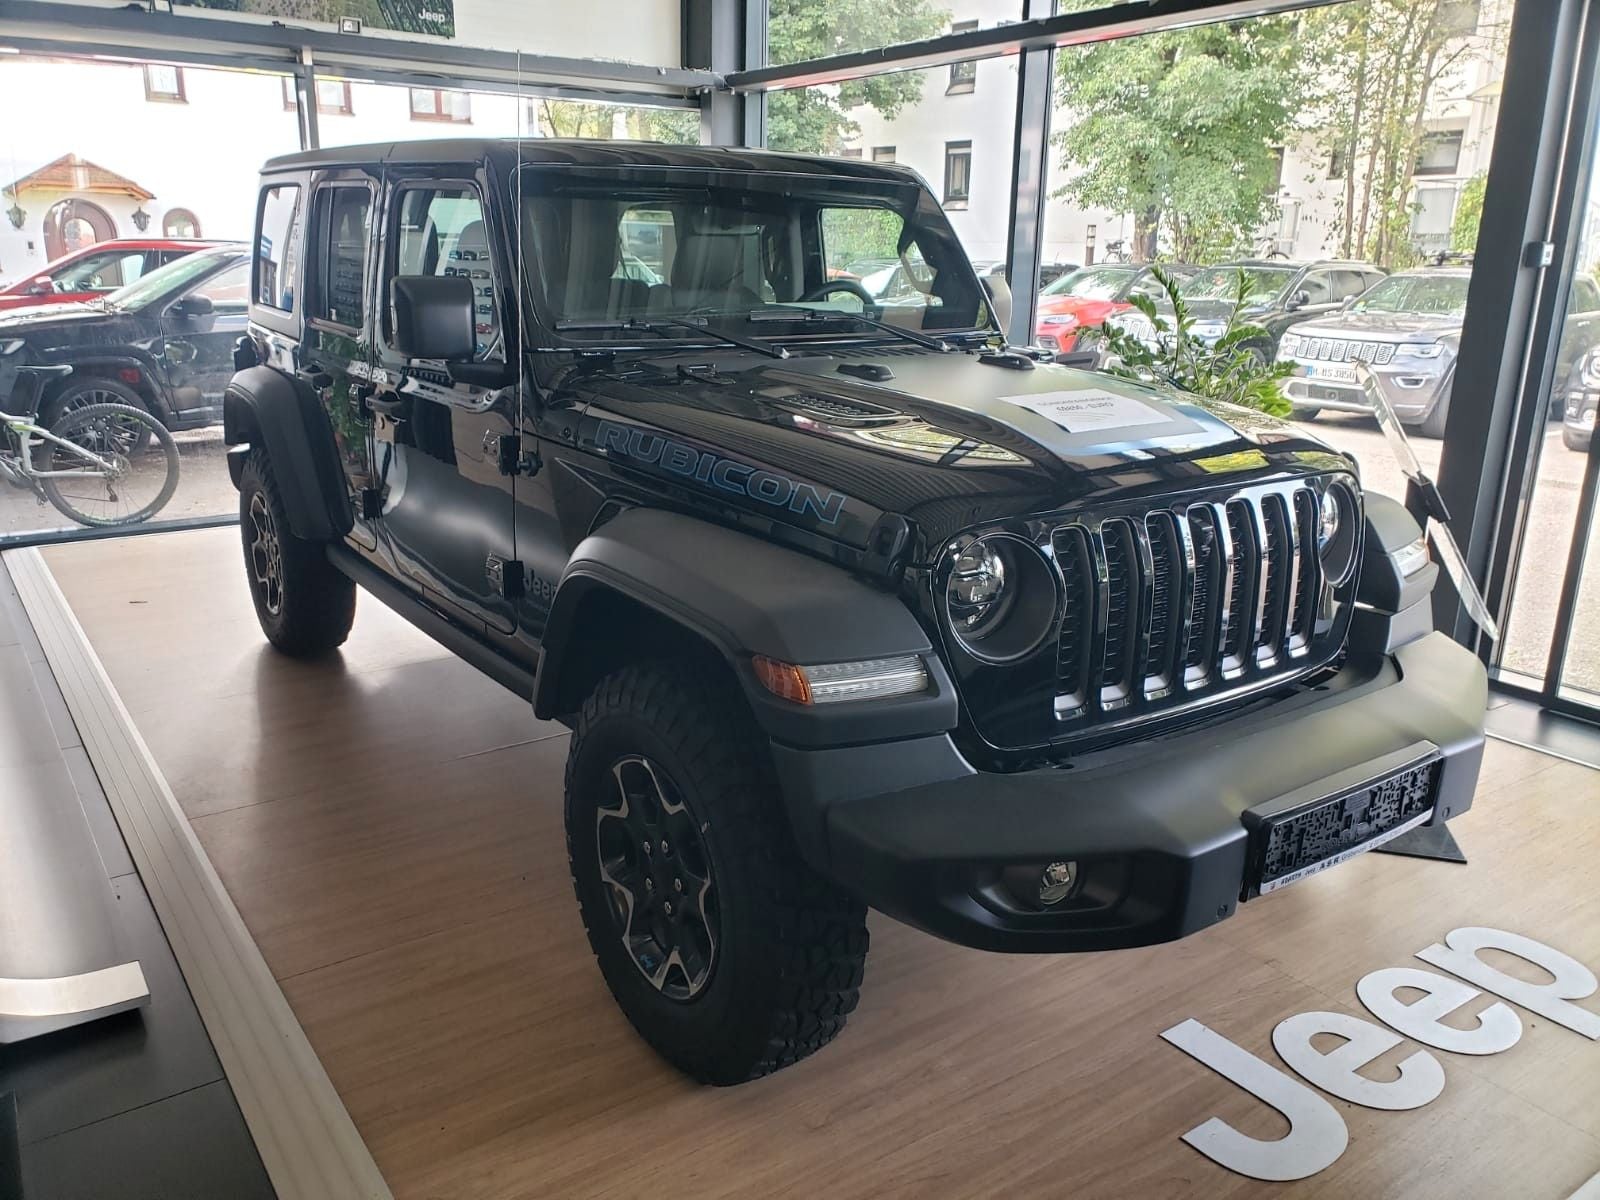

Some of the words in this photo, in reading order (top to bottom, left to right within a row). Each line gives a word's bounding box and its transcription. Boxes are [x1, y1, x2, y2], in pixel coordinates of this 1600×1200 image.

[418, 7, 446, 24] Jeep
[595, 420, 847, 524] RUBICON
[1158, 926, 1600, 1183] Jeep
